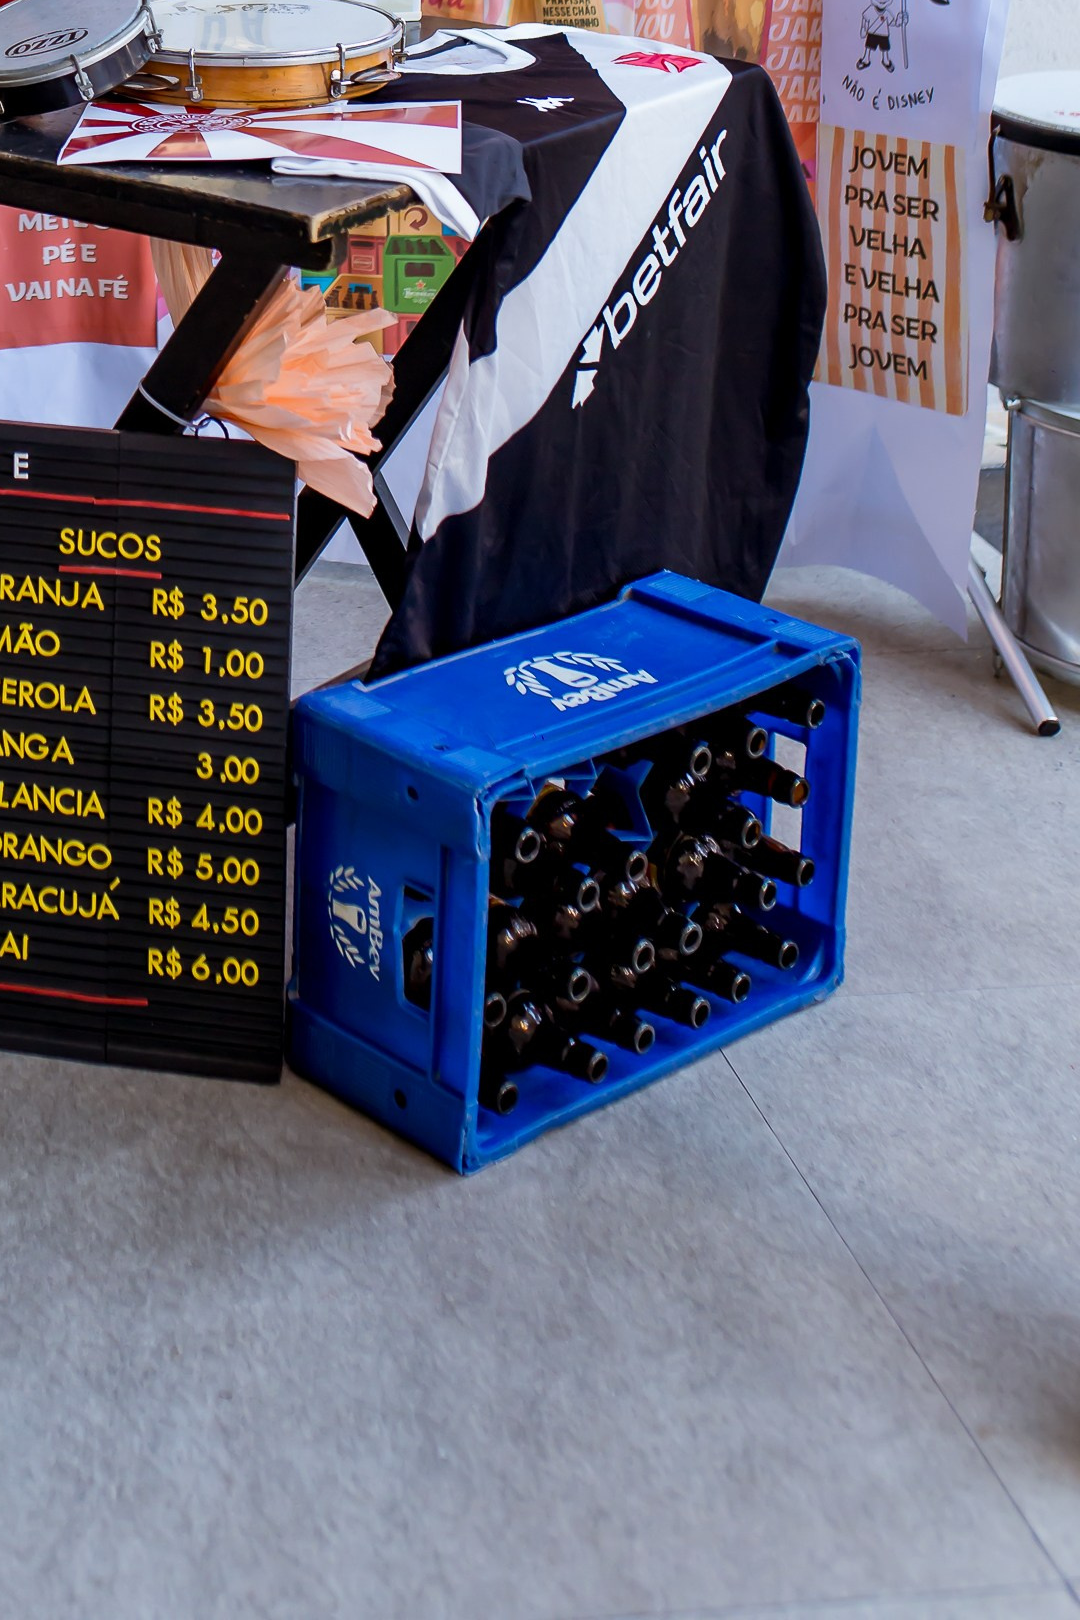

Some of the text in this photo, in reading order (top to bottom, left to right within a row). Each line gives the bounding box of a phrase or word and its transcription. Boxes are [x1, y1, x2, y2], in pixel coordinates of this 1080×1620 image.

[842, 74, 934, 111] NÃO É DISNEY
[849, 145, 928, 179] JOVEM
[845, 185, 940, 221] PRA SER
[43, 240, 96, 265] PÉ E
[602, 129, 728, 349] betfair
[849, 226, 926, 259] VELHA
[6, 276, 128, 302] VAI NA FÉ
[845, 264, 940, 303] E VELHA
[844, 303, 937, 343] PRA SER
[849, 344, 927, 380] JOVEM
[59, 528, 161, 562] SUCOS
[153, 587, 184, 619] R$
[201, 594, 268, 625] 3,50
[150, 640, 184, 672] R$
[203, 646, 264, 678] 1,00
[551, 669, 658, 711] AmBev
[149, 692, 183, 725] R$
[198, 699, 262, 732] 3,50
[148, 796, 182, 828] R$
[196, 803, 263, 836] 4,00
[148, 846, 183, 878] R$
[196, 853, 260, 885] 5,00
[149, 897, 181, 929] R$
[191, 903, 259, 936] 4,50
[365, 874, 384, 982] AmBev
[148, 946, 181, 979] R$
[192, 954, 259, 986] 6,00
